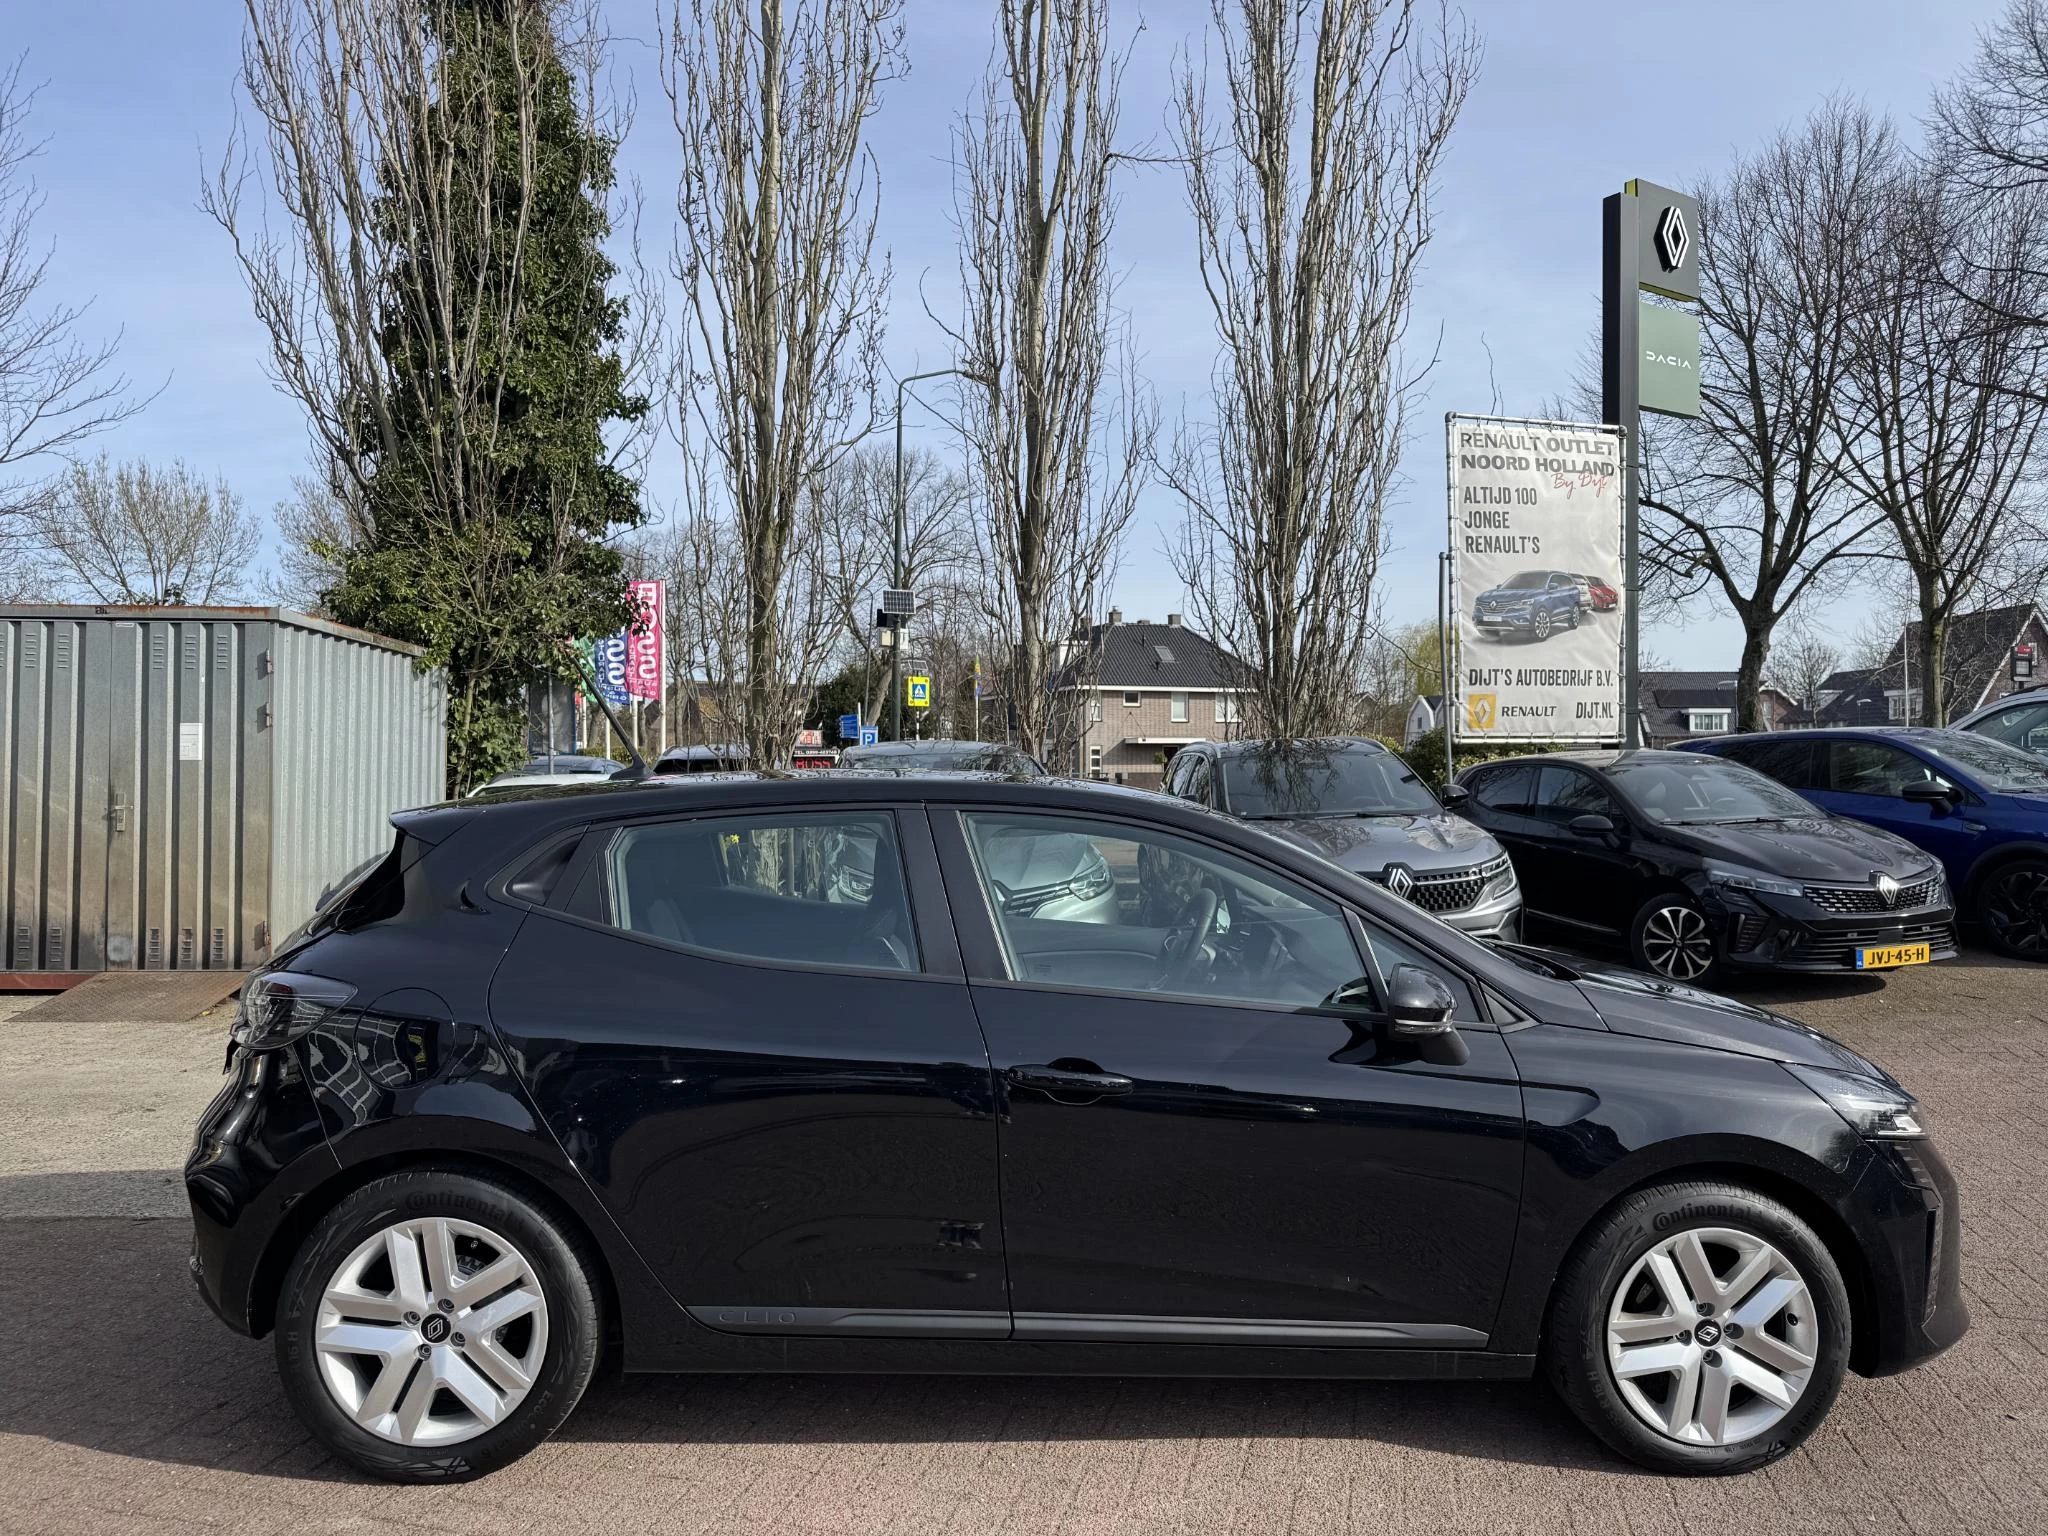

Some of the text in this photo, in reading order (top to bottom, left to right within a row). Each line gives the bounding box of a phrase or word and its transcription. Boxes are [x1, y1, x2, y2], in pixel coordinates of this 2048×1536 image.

[1645, 350, 1692, 370] DACIA
[1460, 432, 1614, 456] RENAULT OUTLET
[1461, 454, 1614, 477] NOORD HOLLAND
[1463, 486, 1537, 506] ALTIJD 100
[1464, 511, 1510, 529] JONGE
[1465, 535, 1540, 554] RENAULT'S
[1469, 668, 1614, 687] DIJT'S AUTOBEDRIJF B.V.
[1501, 702, 1614, 719] RENAULT DIJT.NL
[866, 735, 873, 746] P
[1868, 947, 1924, 965] JVJ-45-H
[405, 1191, 512, 1219] Continental
[1653, 1203, 1754, 1230] Continental
[719, 1311, 796, 1323] CLIO
